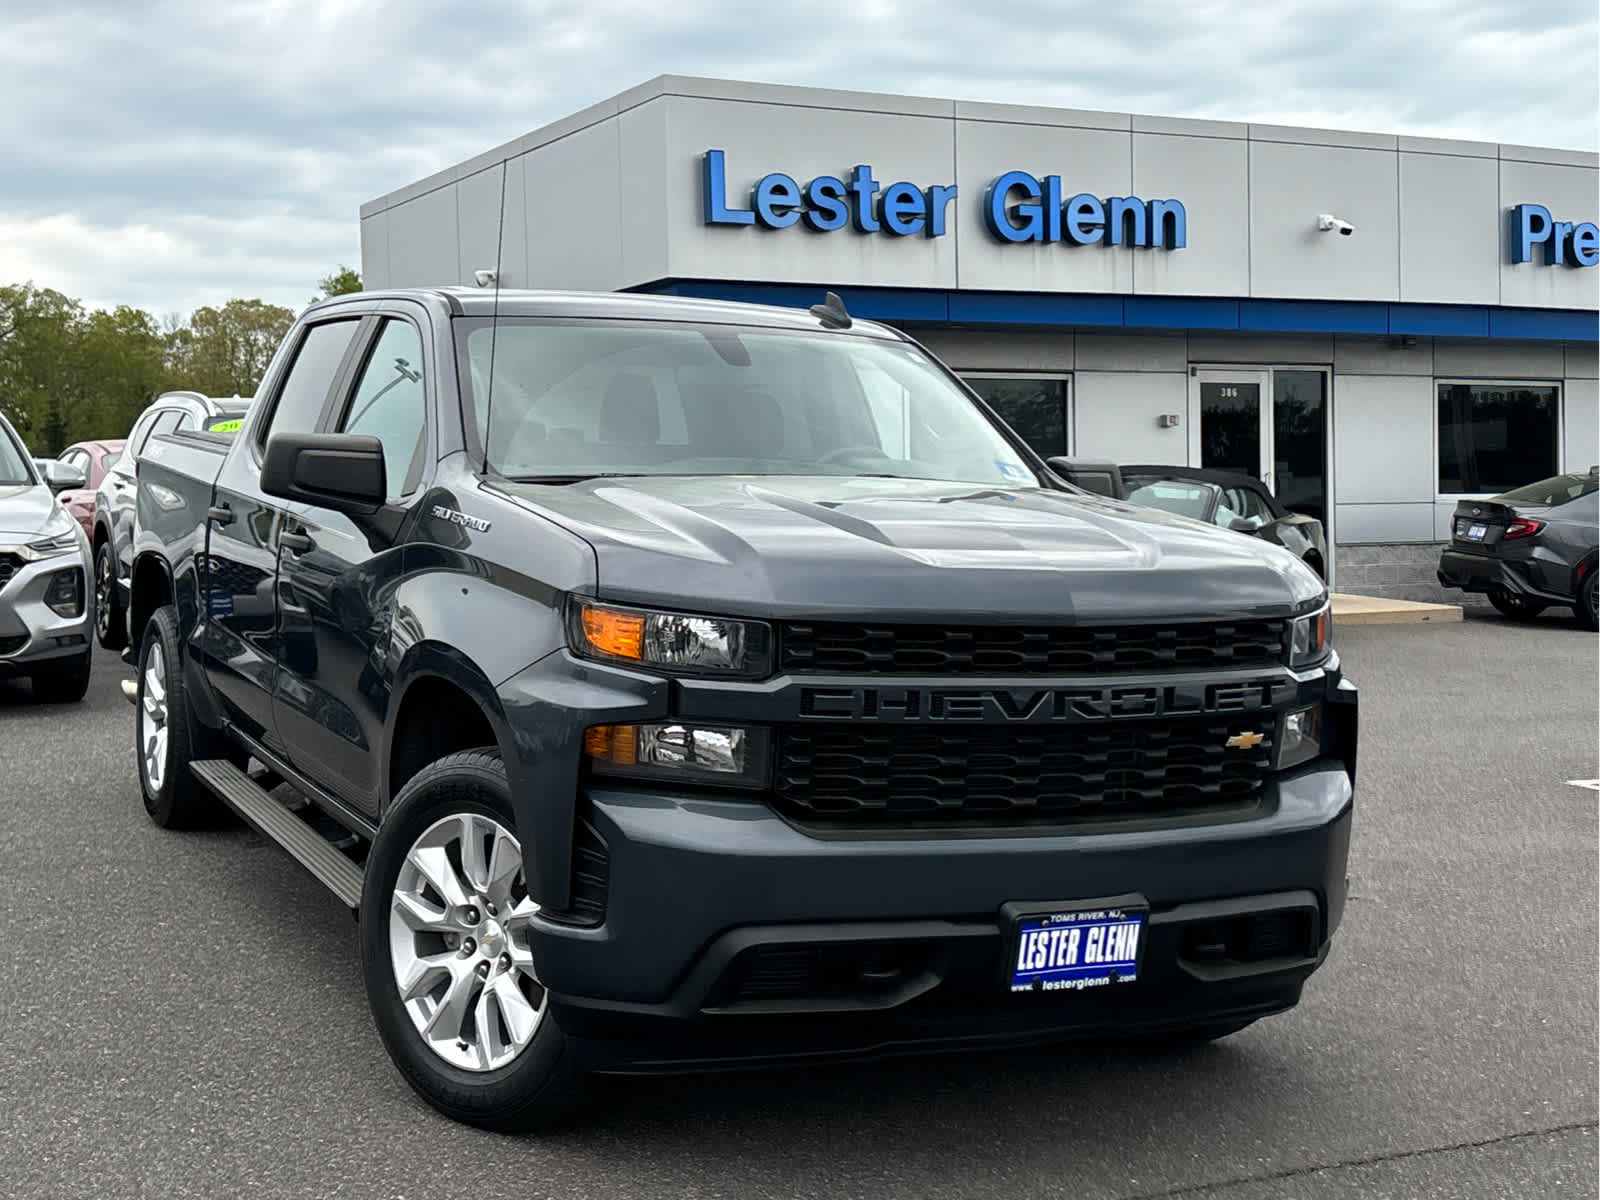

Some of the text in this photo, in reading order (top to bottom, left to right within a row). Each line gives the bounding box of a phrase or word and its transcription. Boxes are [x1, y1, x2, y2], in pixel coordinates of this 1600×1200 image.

[702, 149, 1188, 250] Lester Glenn
[1511, 203, 1600, 267] Pre
[799, 681, 1287, 721] CHEVROLET
[1051, 914, 1076, 923] TOMS
[1109, 910, 1120, 919] NJ
[1017, 924, 1140, 971] LESTER GLENN
